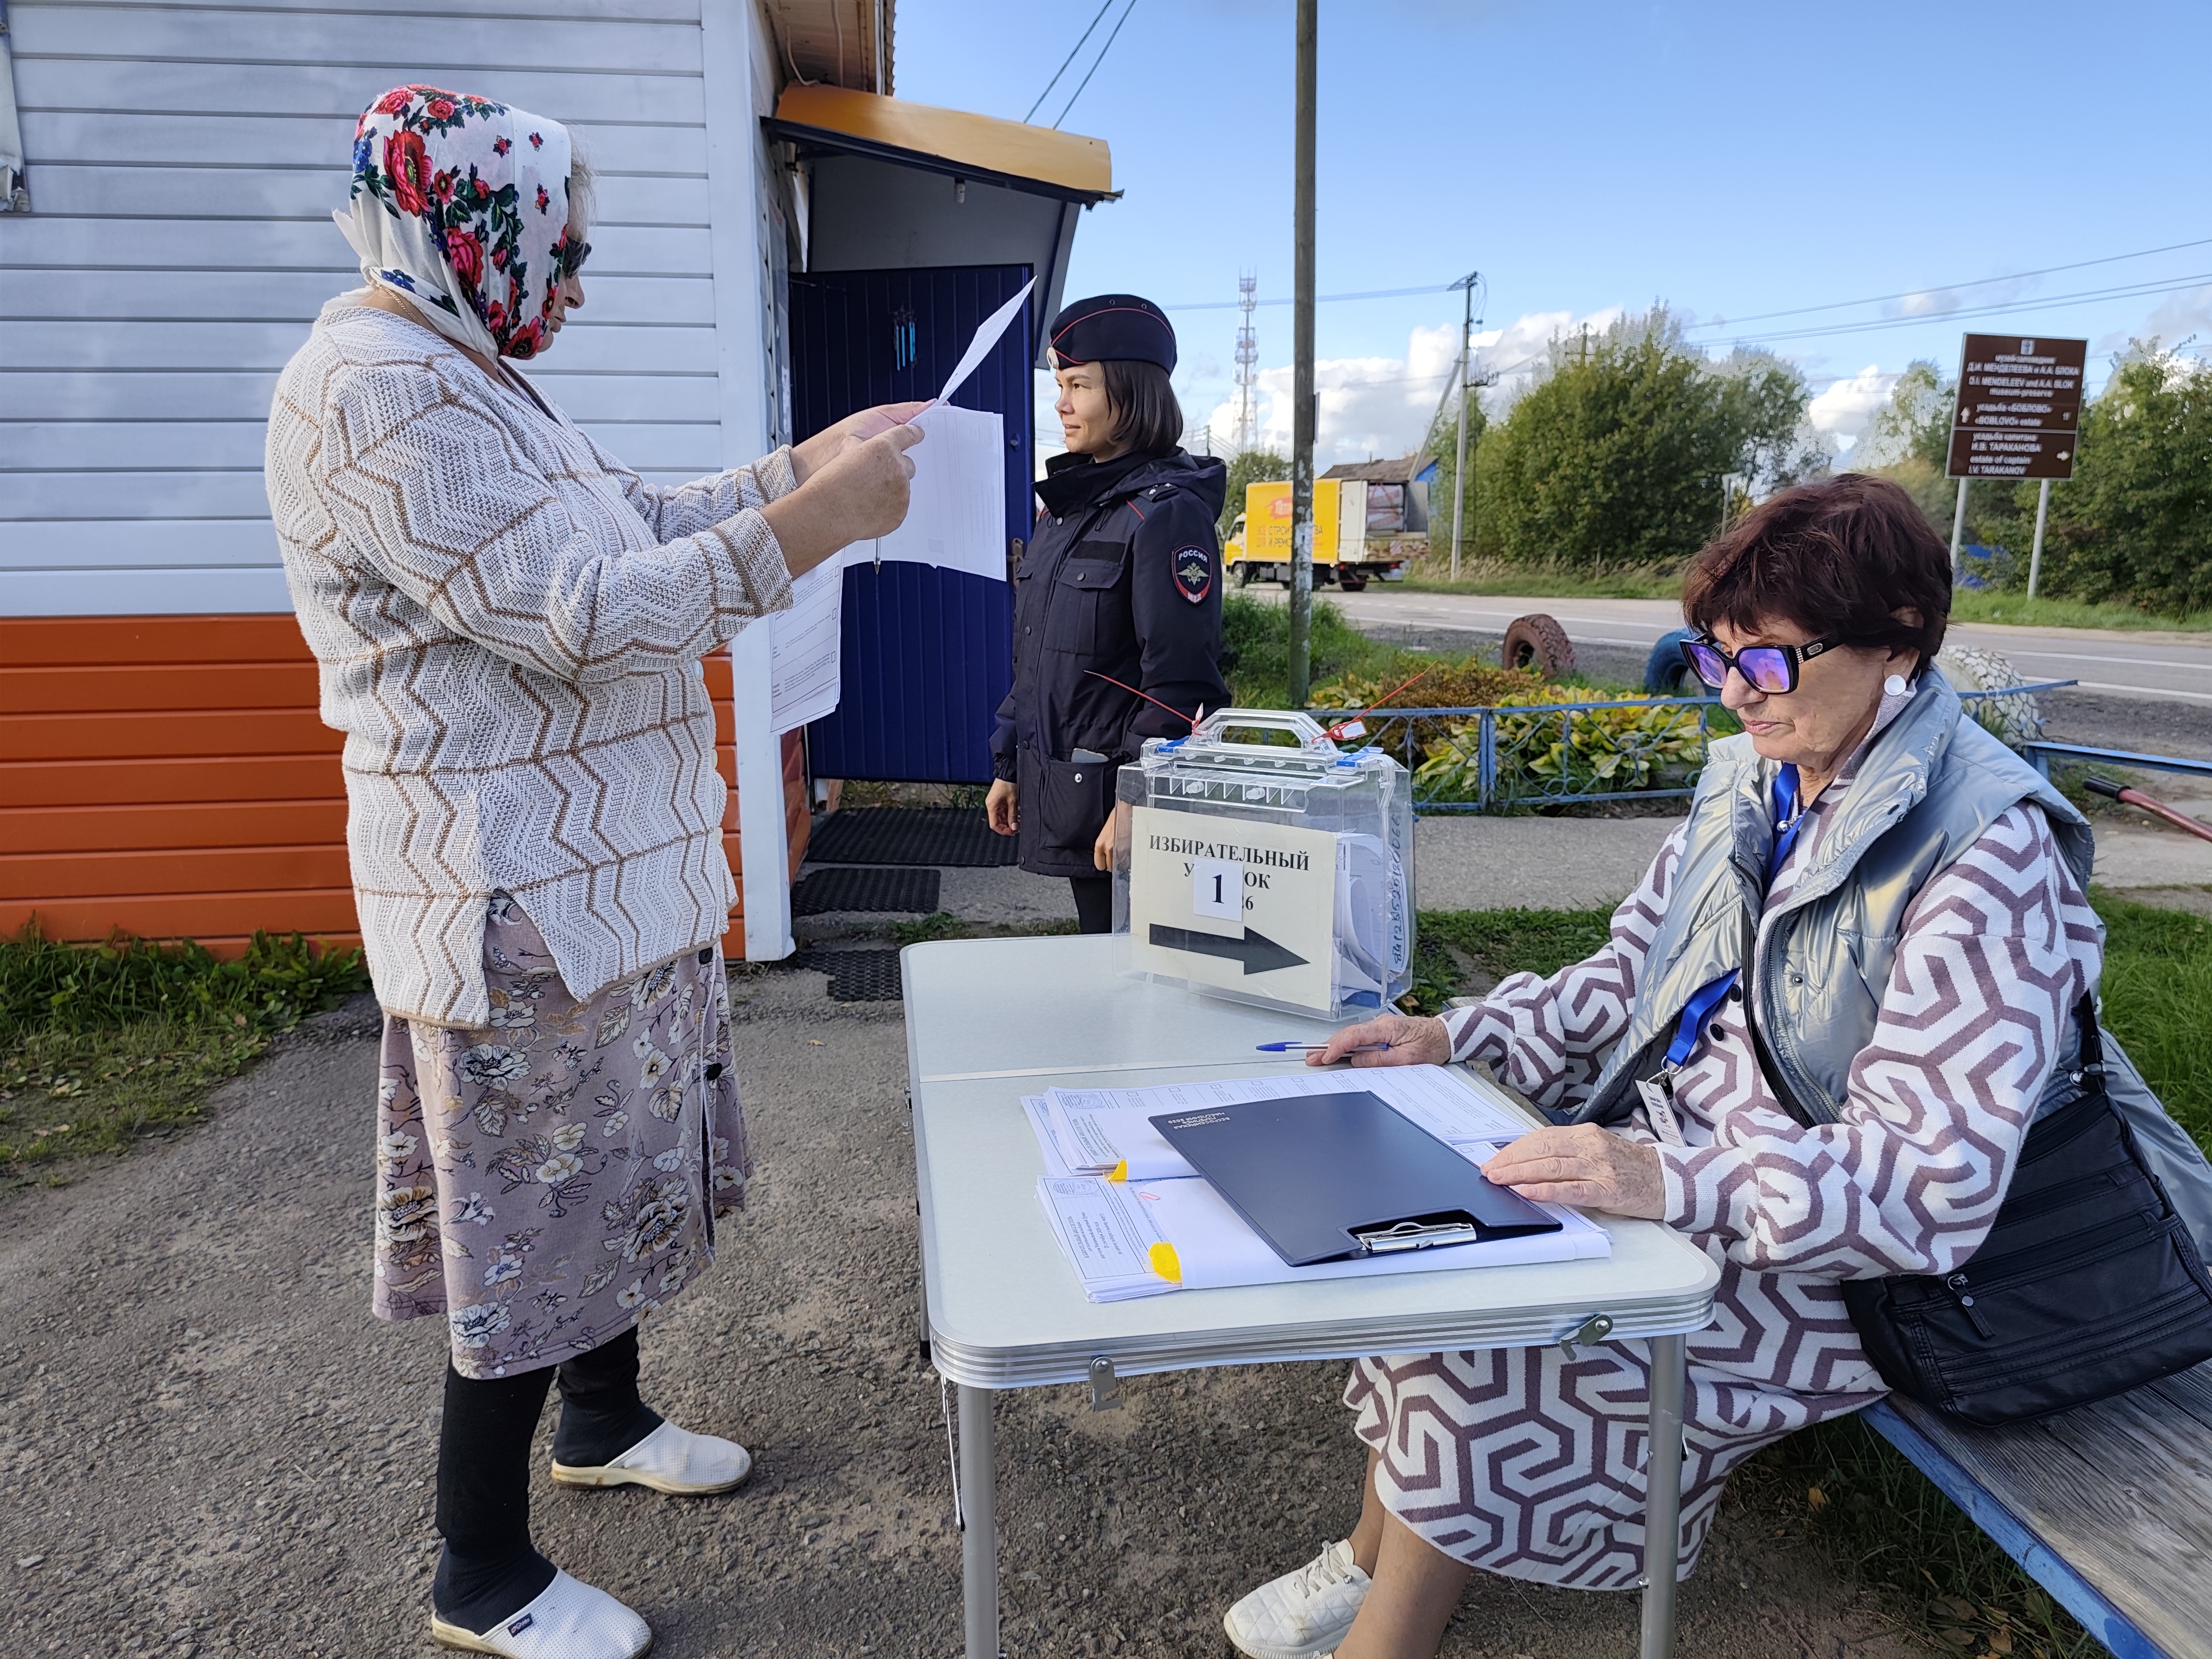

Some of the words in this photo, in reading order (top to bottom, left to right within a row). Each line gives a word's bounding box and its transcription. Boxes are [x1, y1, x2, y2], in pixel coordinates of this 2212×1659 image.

[1984, 362, 2033, 374] МЕНДЕЛЕЕВА
[2055, 366, 2080, 376] БЛОКА
[1982, 376, 2025, 387] MENDELEEV
[2025, 378, 2038, 387] and
[2054, 380, 2075, 389] BLOK
[1989, 388, 2054, 397] museum-preserve
[1977, 403, 2006, 412] усадьба
[2020, 417, 2042, 427] estate
[1973, 432, 2003, 441] усадьба
[2004, 433, 2039, 442] капитана
[1989, 442, 2043, 452] ТАРАКАНОВА
[1970, 455, 1994, 464] estate
[1995, 455, 2003, 464] of
[2004, 456, 2032, 465] captain
[1981, 465, 2027, 475] TARAKANOV
[1179, 549, 1207, 563] РОССИЯ
[1187, 592, 1202, 603] МВД
[1149, 835, 1310, 871] ИЗБИРАТЕЛЬНЫЙ
[1212, 874, 1225, 904] 1
[1185, 1112, 1225, 1121] НАСЕЛЕНИЯ
[1173, 1117, 1230, 1129] ВСЕРОССИЙСКАЯ
